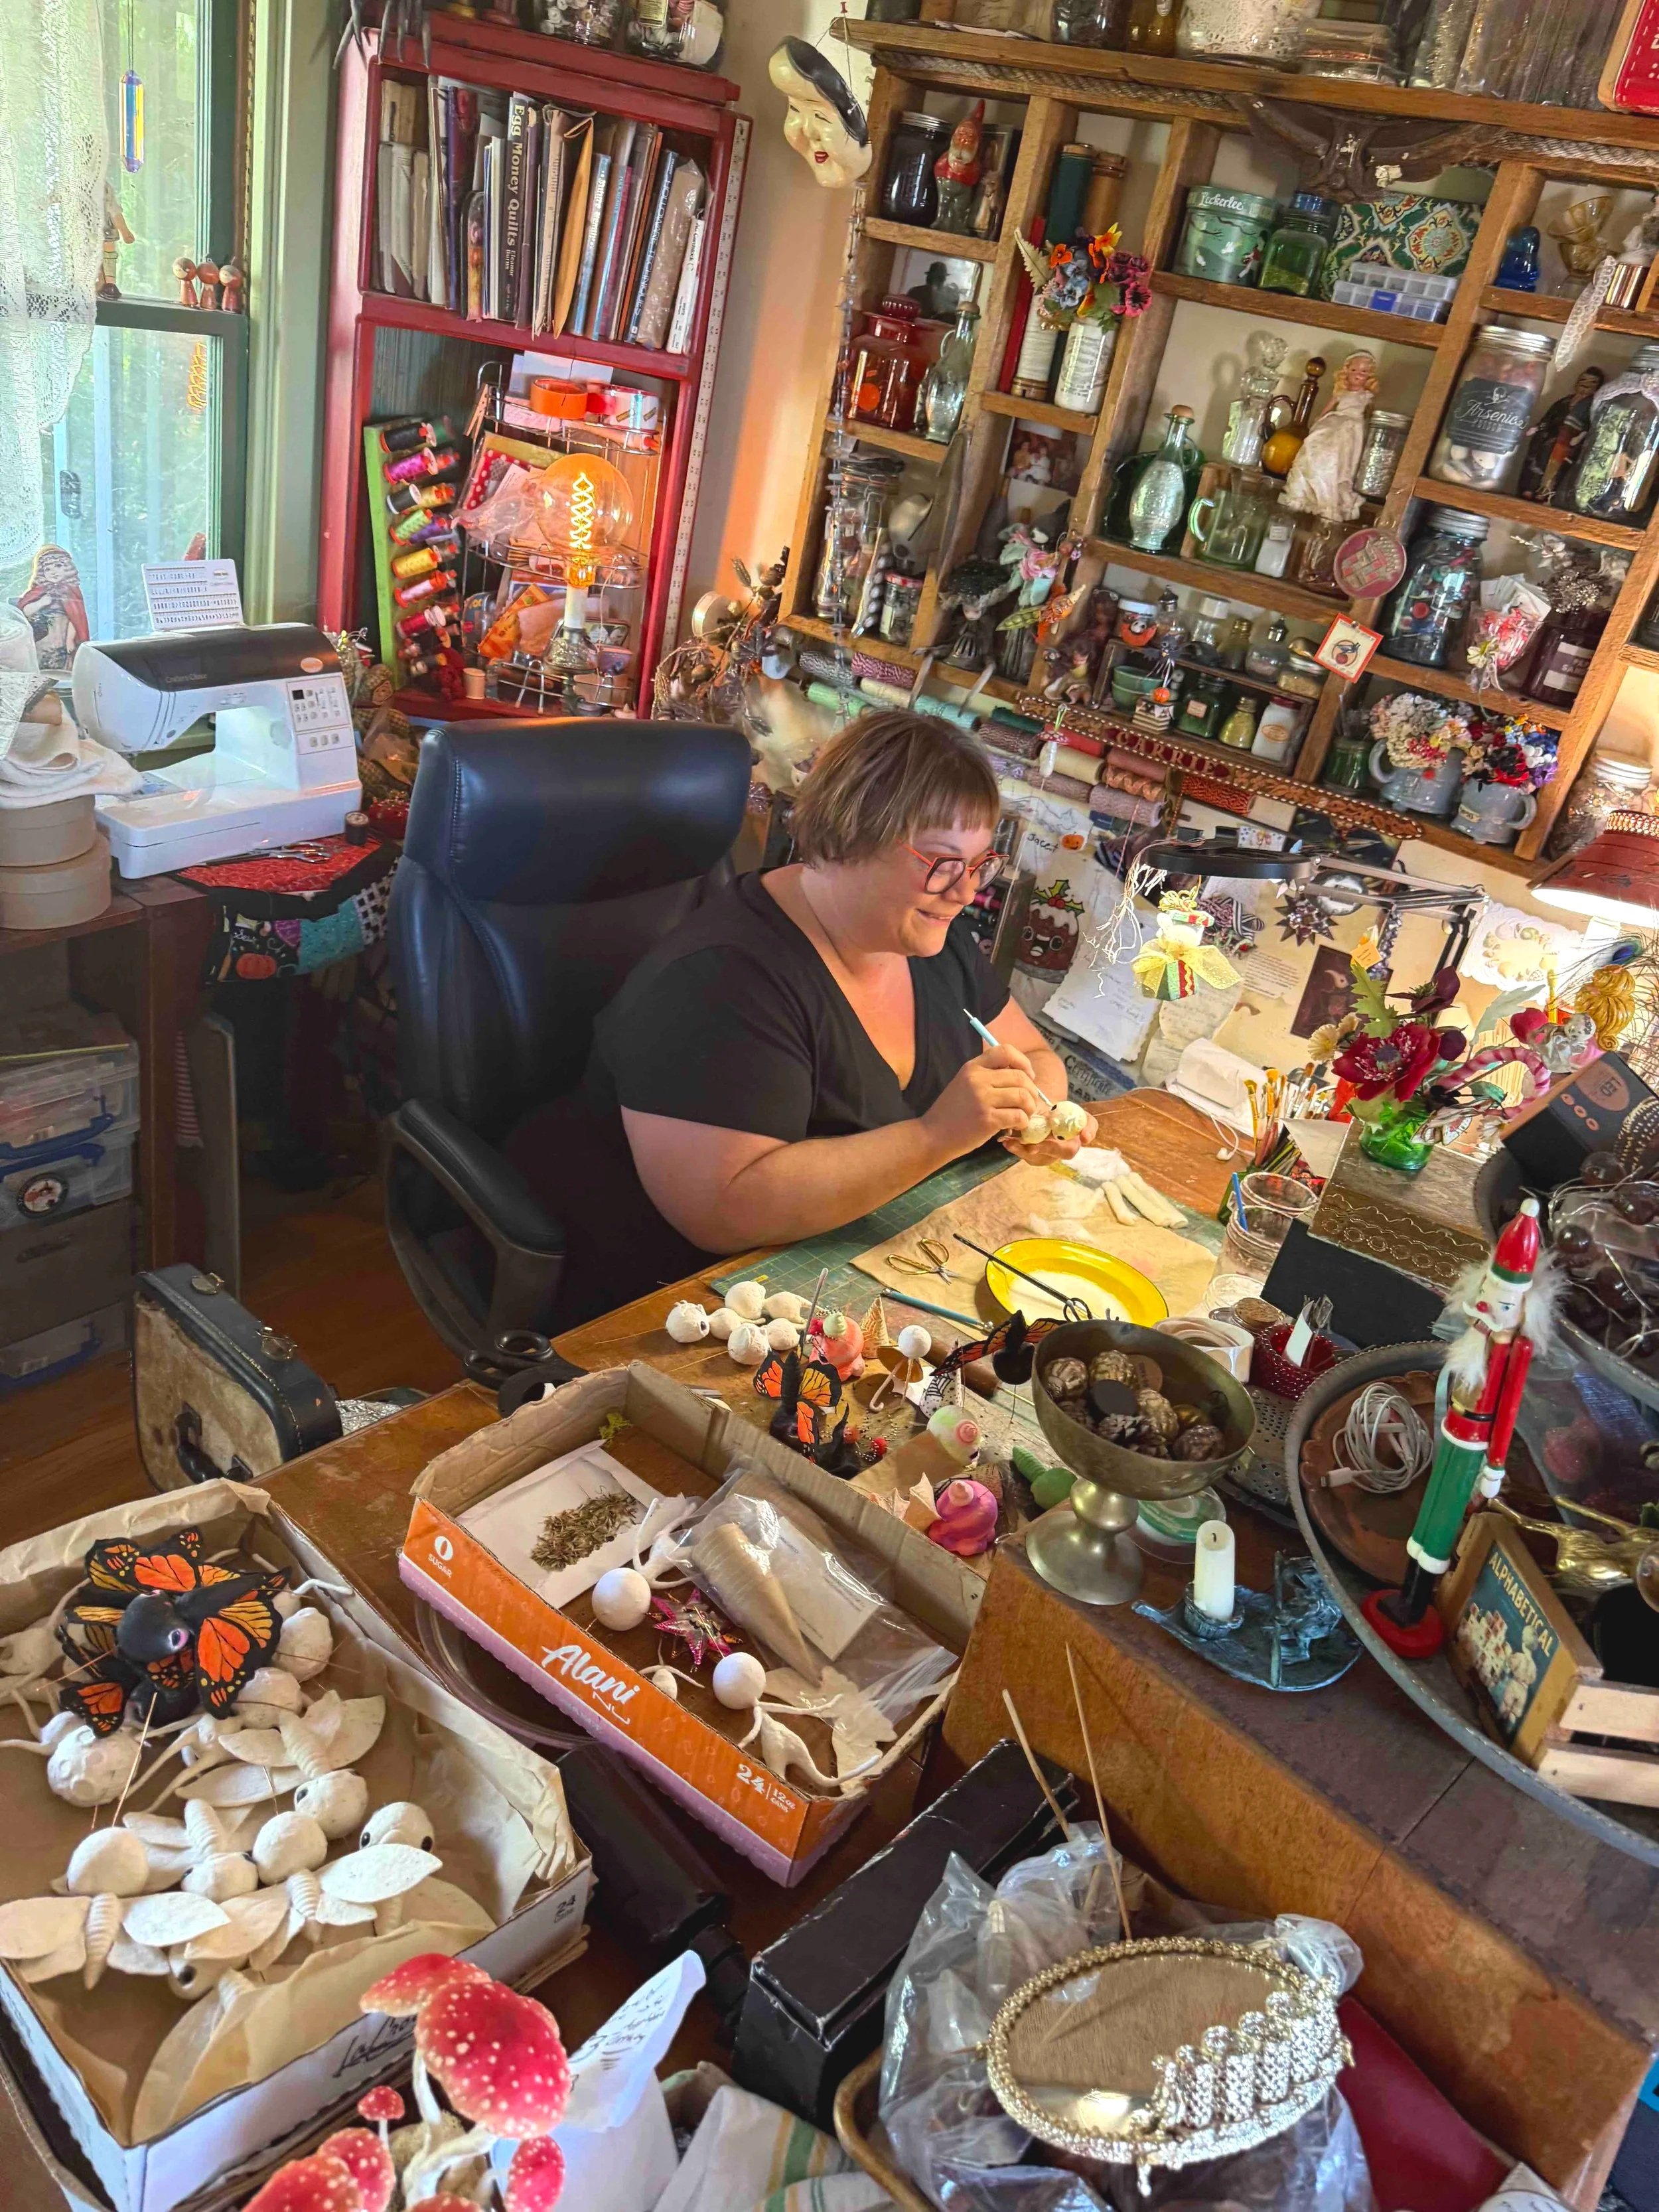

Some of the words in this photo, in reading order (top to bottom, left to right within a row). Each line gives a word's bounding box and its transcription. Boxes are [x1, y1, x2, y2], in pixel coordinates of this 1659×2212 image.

[512, 105, 525, 137] Egg
[507, 142, 523, 194] Money
[1198, 191, 1244, 211] Leckerlee
[506, 198, 520, 246] Quilts
[1455, 400, 1530, 429] Arsenic
[1115, 731, 1216, 773] CARRIE
[435, 1536, 453, 1561] 0
[428, 1554, 452, 1578] SUGAR
[1488, 1551, 1553, 1657] ALPHABETICAL
[541, 1645, 640, 1704] Alani
[736, 1763, 765, 1794] 24
[556, 1894, 576, 1917] 24
